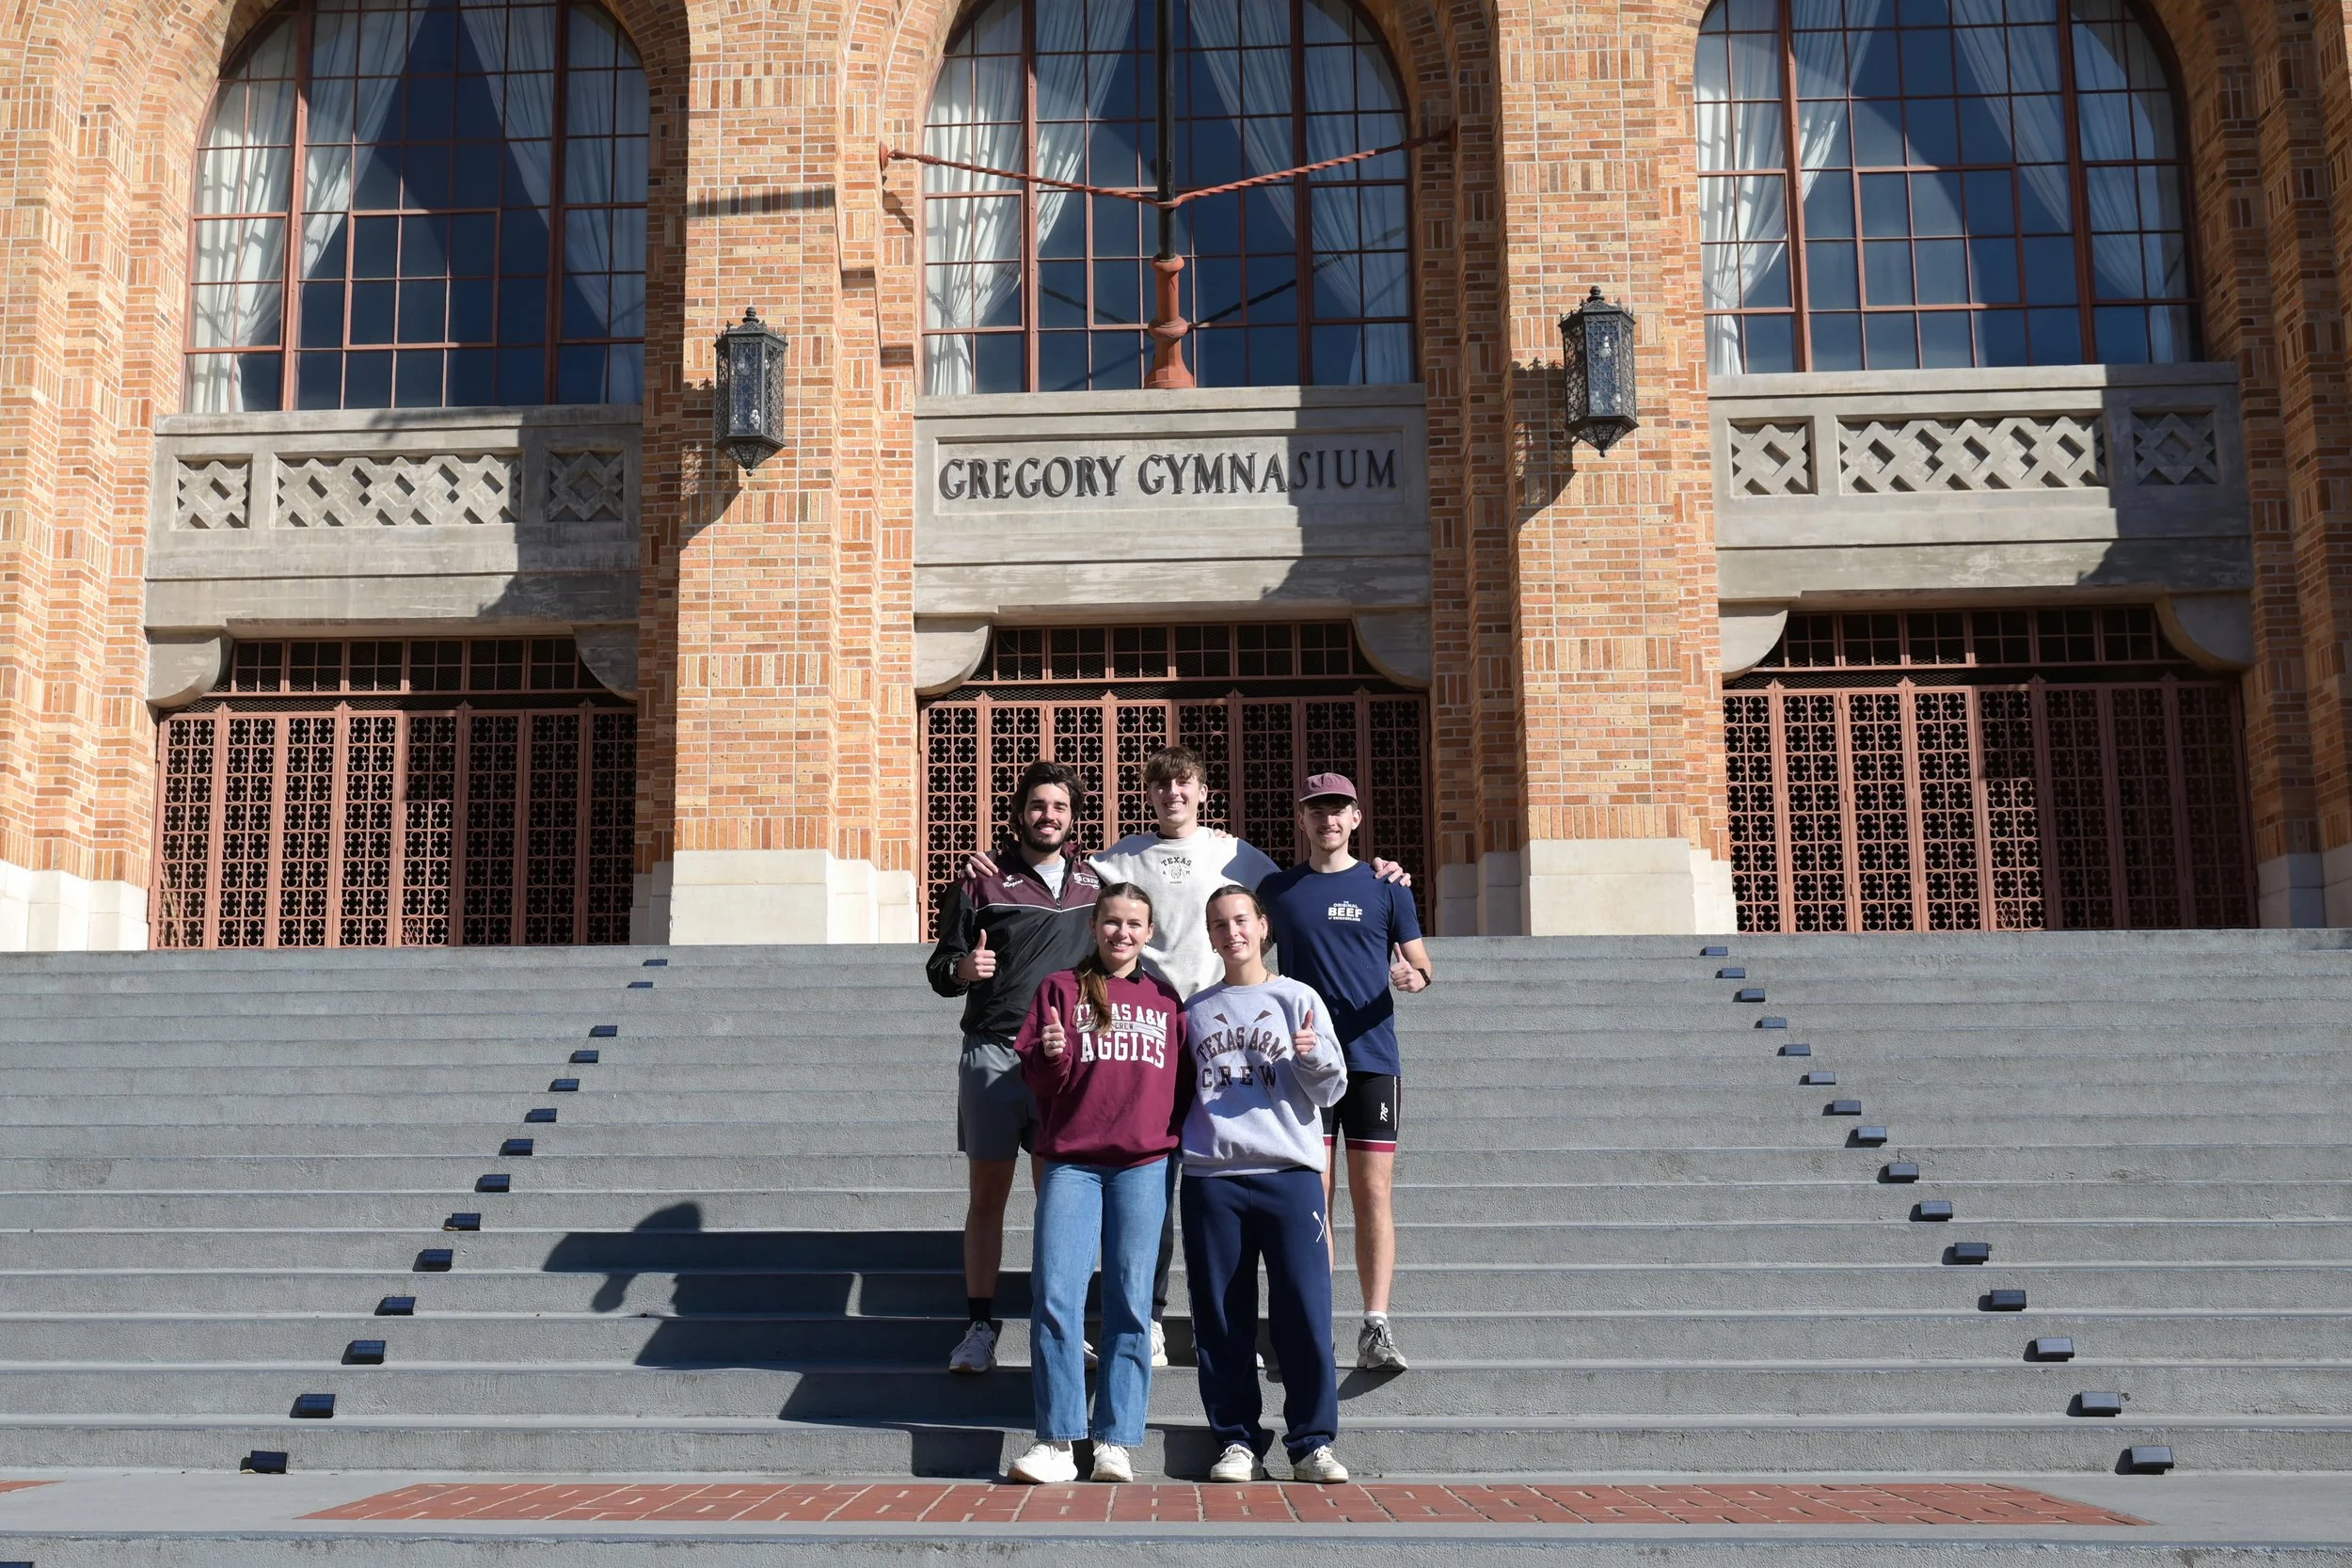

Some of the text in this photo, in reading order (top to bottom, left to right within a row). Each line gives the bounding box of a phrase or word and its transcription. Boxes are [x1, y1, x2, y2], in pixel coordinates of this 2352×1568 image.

[938, 449, 1398, 500] GREGORY GYMNASIUM
[1160, 856, 1192, 866] TEXAS
[1327, 907, 1363, 918] BEEF
[1074, 1003, 1168, 1031] TAS A&M
[1114, 1022, 1135, 1031] CREW
[1080, 1031, 1167, 1069] AGGIES
[1196, 1026, 1288, 1066] TEXAS A&M
[1200, 1065, 1277, 1090] CREW
